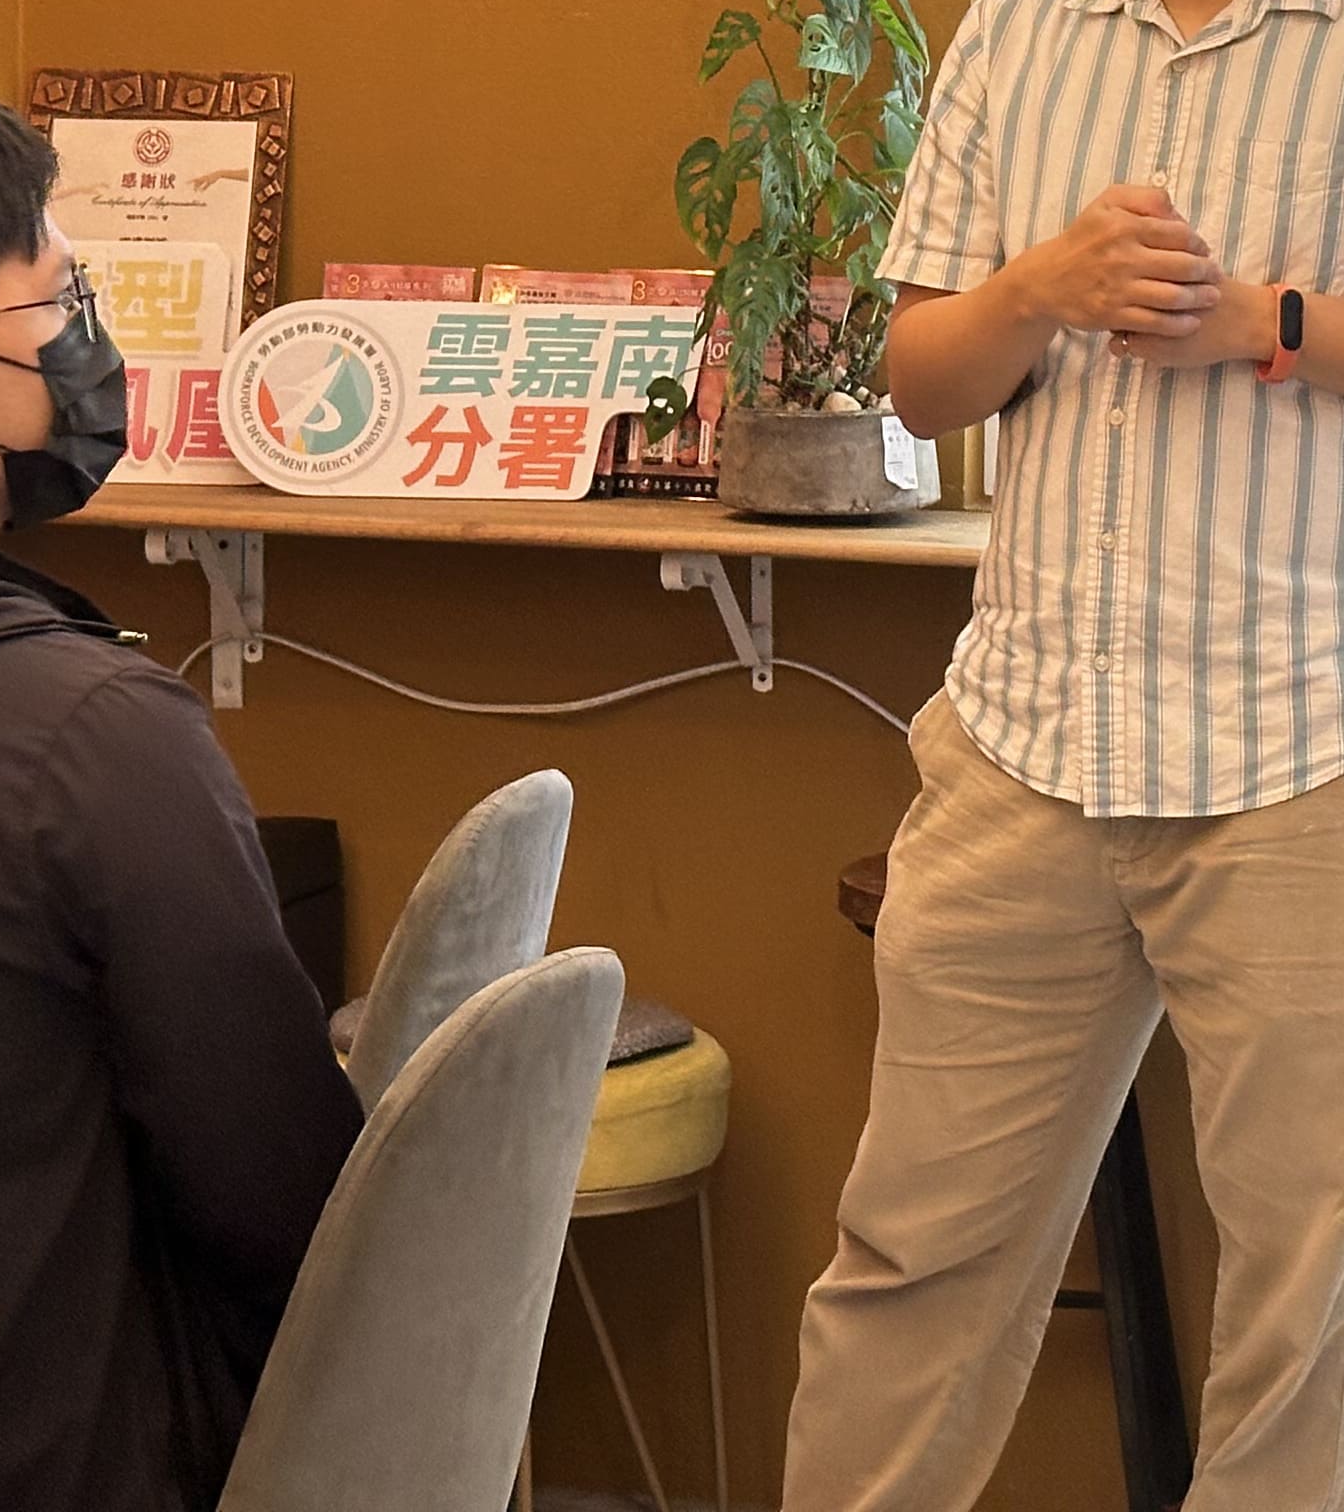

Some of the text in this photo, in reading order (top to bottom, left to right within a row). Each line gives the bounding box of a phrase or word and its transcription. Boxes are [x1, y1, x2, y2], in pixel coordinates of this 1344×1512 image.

[121, 172, 177, 190] 感謝狀
[373, 360, 392, 396] LABOR
[419, 312, 698, 400] 雲嘉南
[239, 360, 259, 425] WORKFORCE
[380, 399, 391, 412] OF
[246, 423, 308, 473] DEVELOPMENT
[354, 414, 389, 458] MINISTRY
[402, 404, 591, 491] 分署
